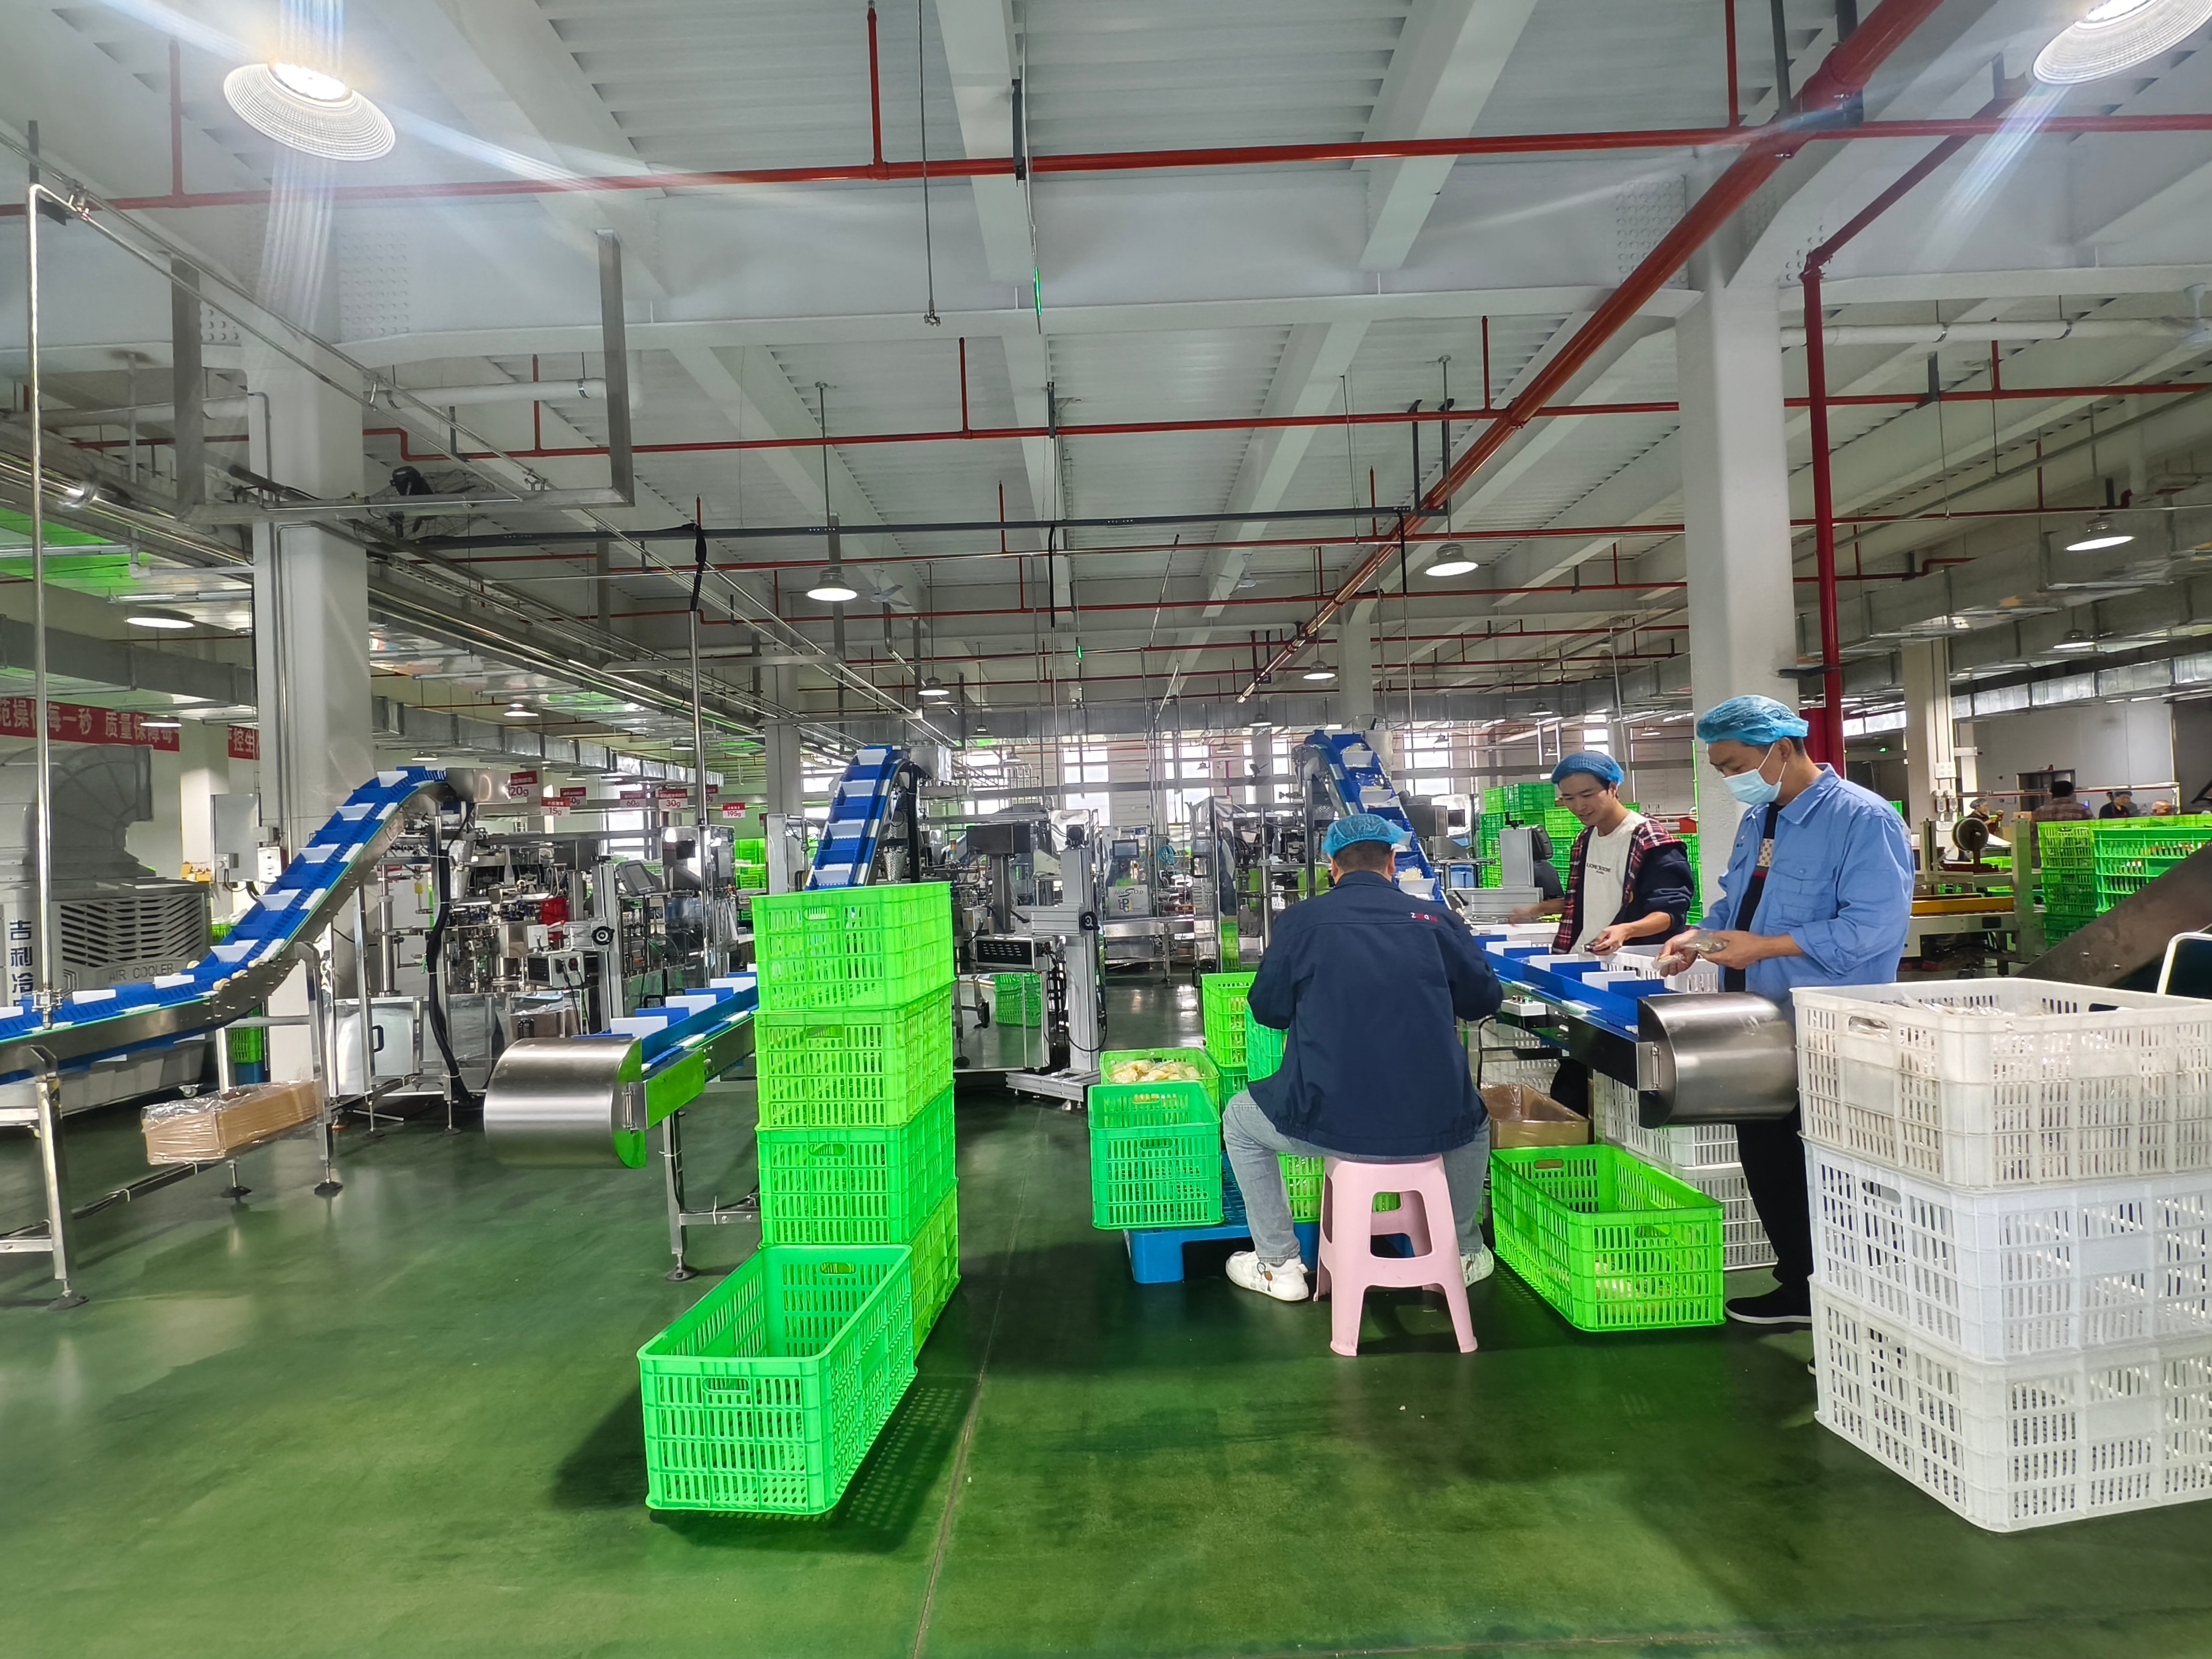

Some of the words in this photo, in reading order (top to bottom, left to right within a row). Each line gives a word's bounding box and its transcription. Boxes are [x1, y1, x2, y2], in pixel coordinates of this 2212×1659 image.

[666, 800, 681, 808] 30g
[549, 807, 562, 815] 15g
[109, 969, 127, 981] AIR
[133, 963, 173, 979] COOLER
